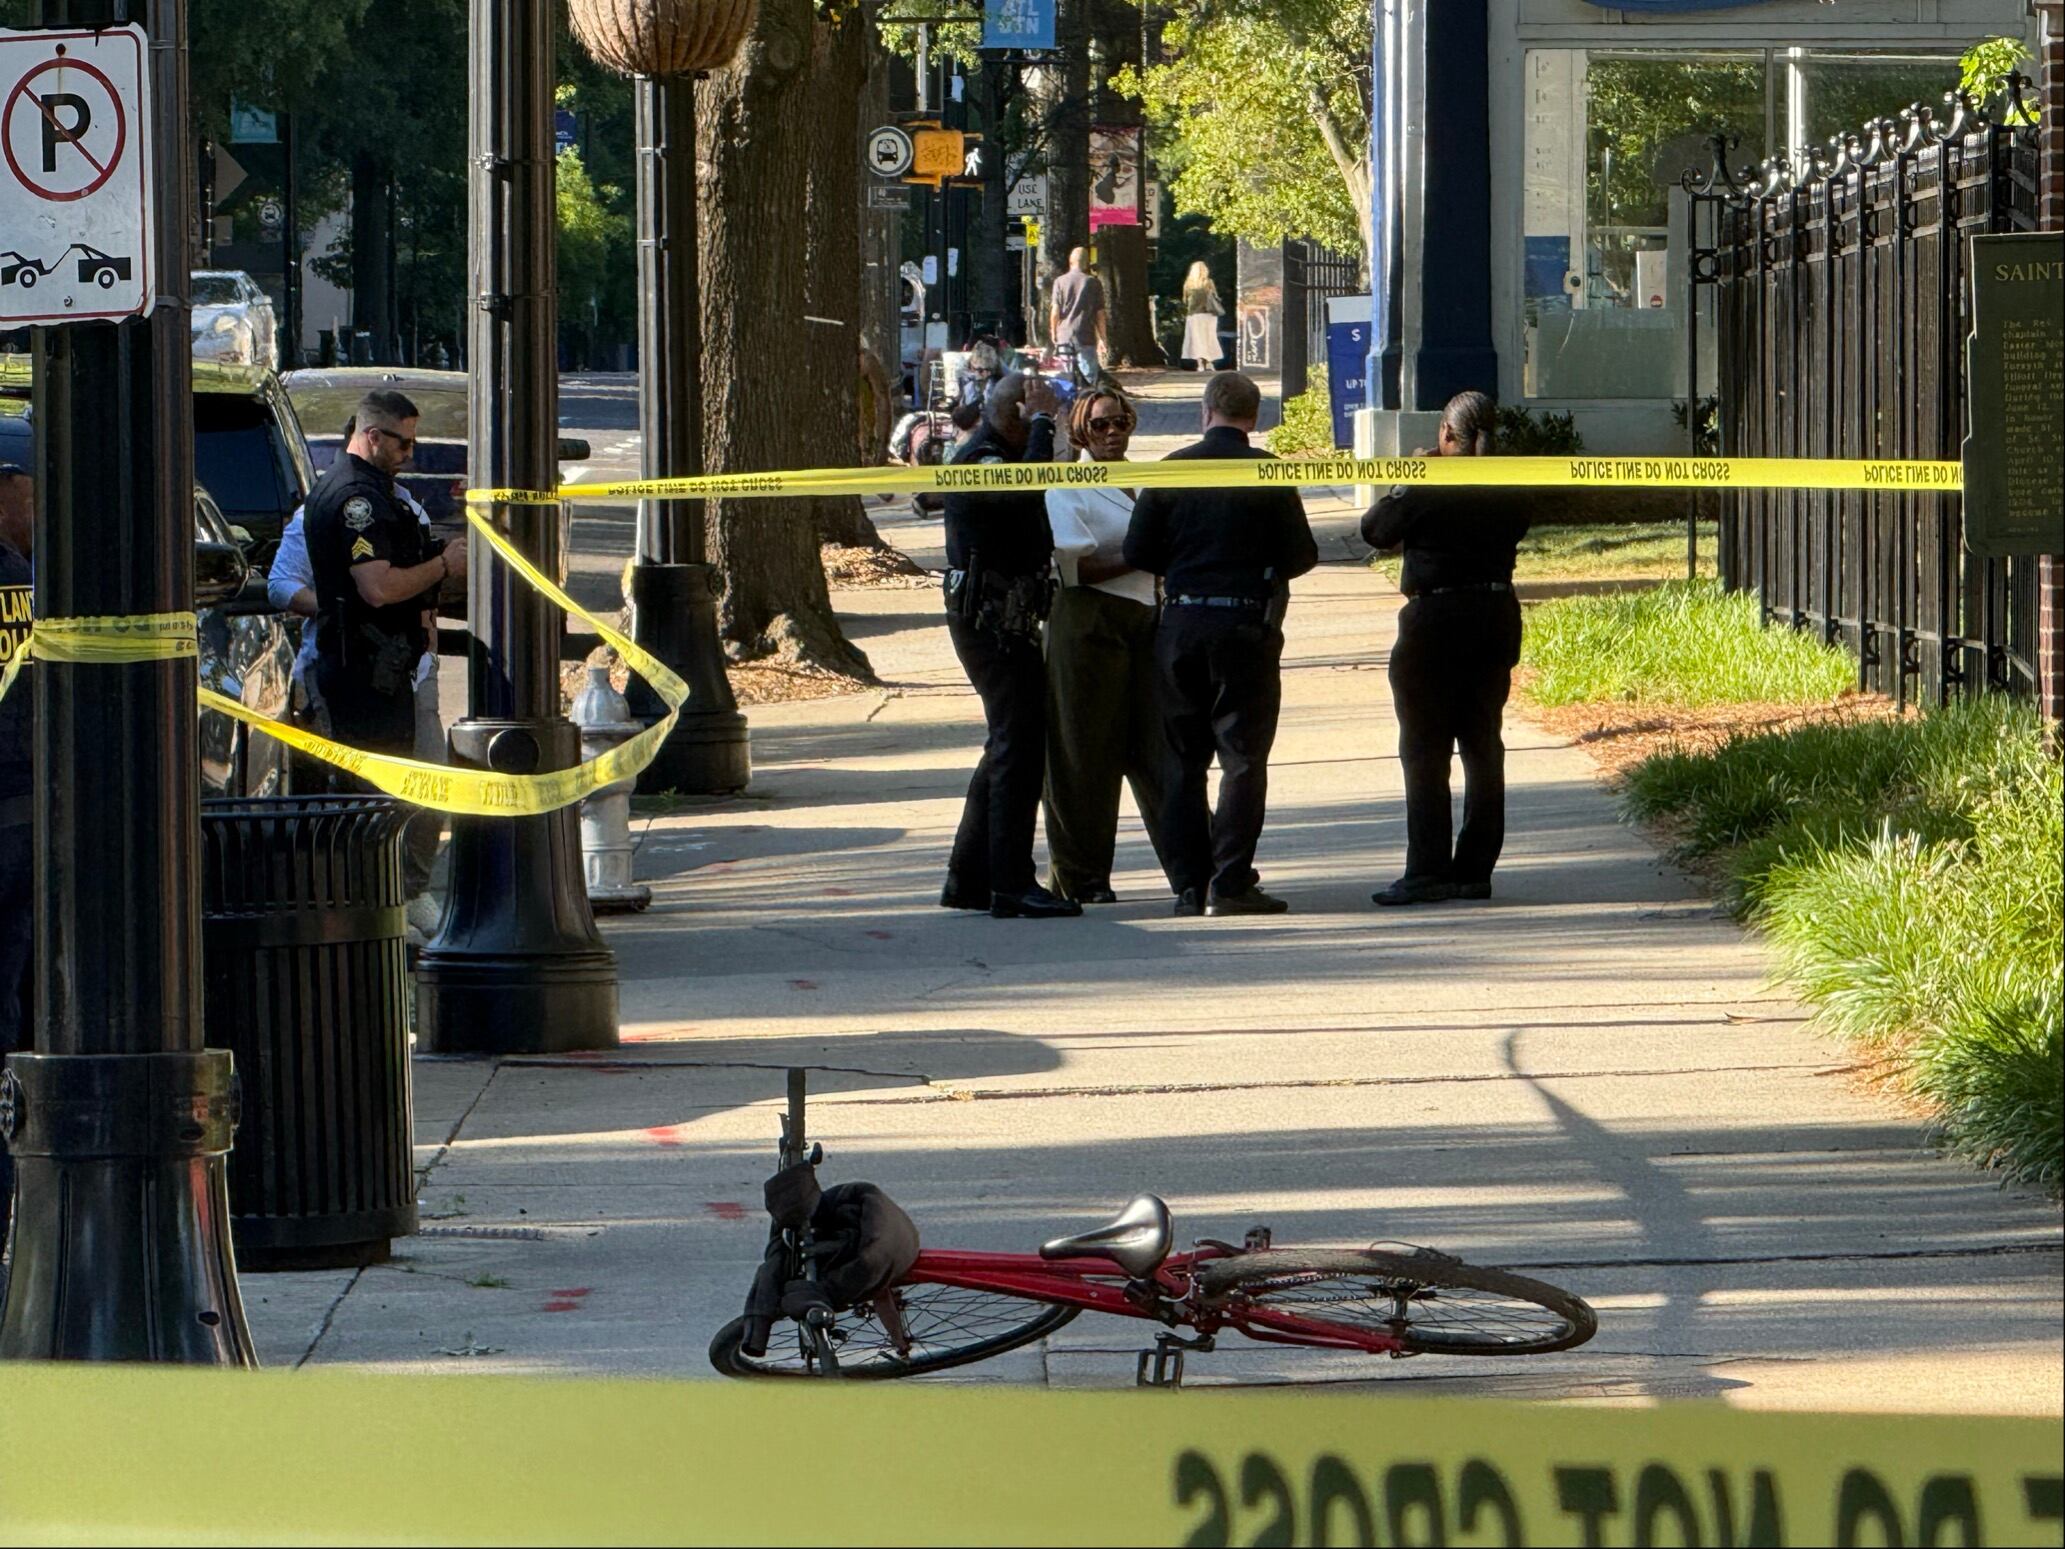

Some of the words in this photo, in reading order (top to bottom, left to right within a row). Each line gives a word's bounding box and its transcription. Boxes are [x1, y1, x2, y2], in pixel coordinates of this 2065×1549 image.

[1018, 184, 1037, 195] USE
[1017, 198, 1041, 209] LANE
[1351, 328, 1361, 342] S
